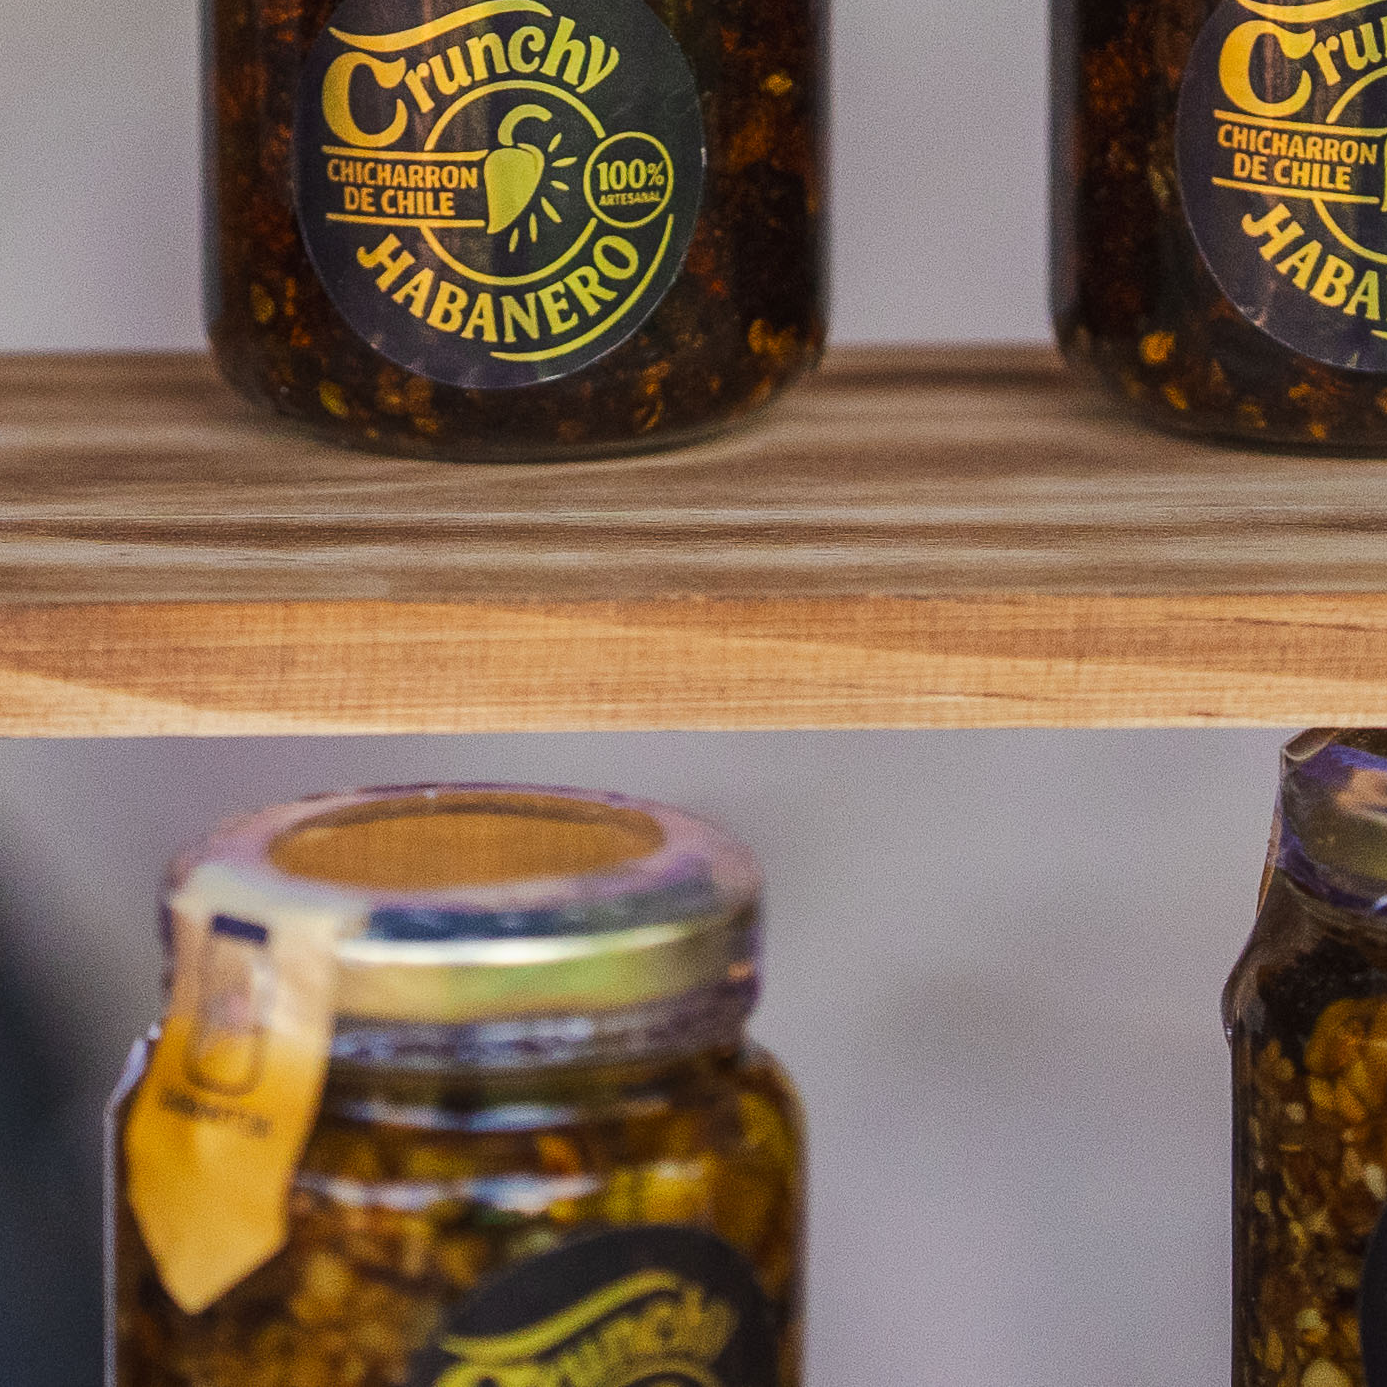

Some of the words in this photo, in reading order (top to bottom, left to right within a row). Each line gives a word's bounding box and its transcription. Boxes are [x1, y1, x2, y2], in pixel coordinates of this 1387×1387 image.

[1217, 123, 1378, 167] CHICHARRON
[326, 158, 479, 191] CHICHARRON
[596, 158, 666, 192] 100%
[1233, 152, 1270, 184] DE
[1274, 159, 1352, 192] CHILE
[344, 186, 381, 214] DE
[384, 187, 456, 216] CHILE
[356, 233, 640, 344] HABANERO
